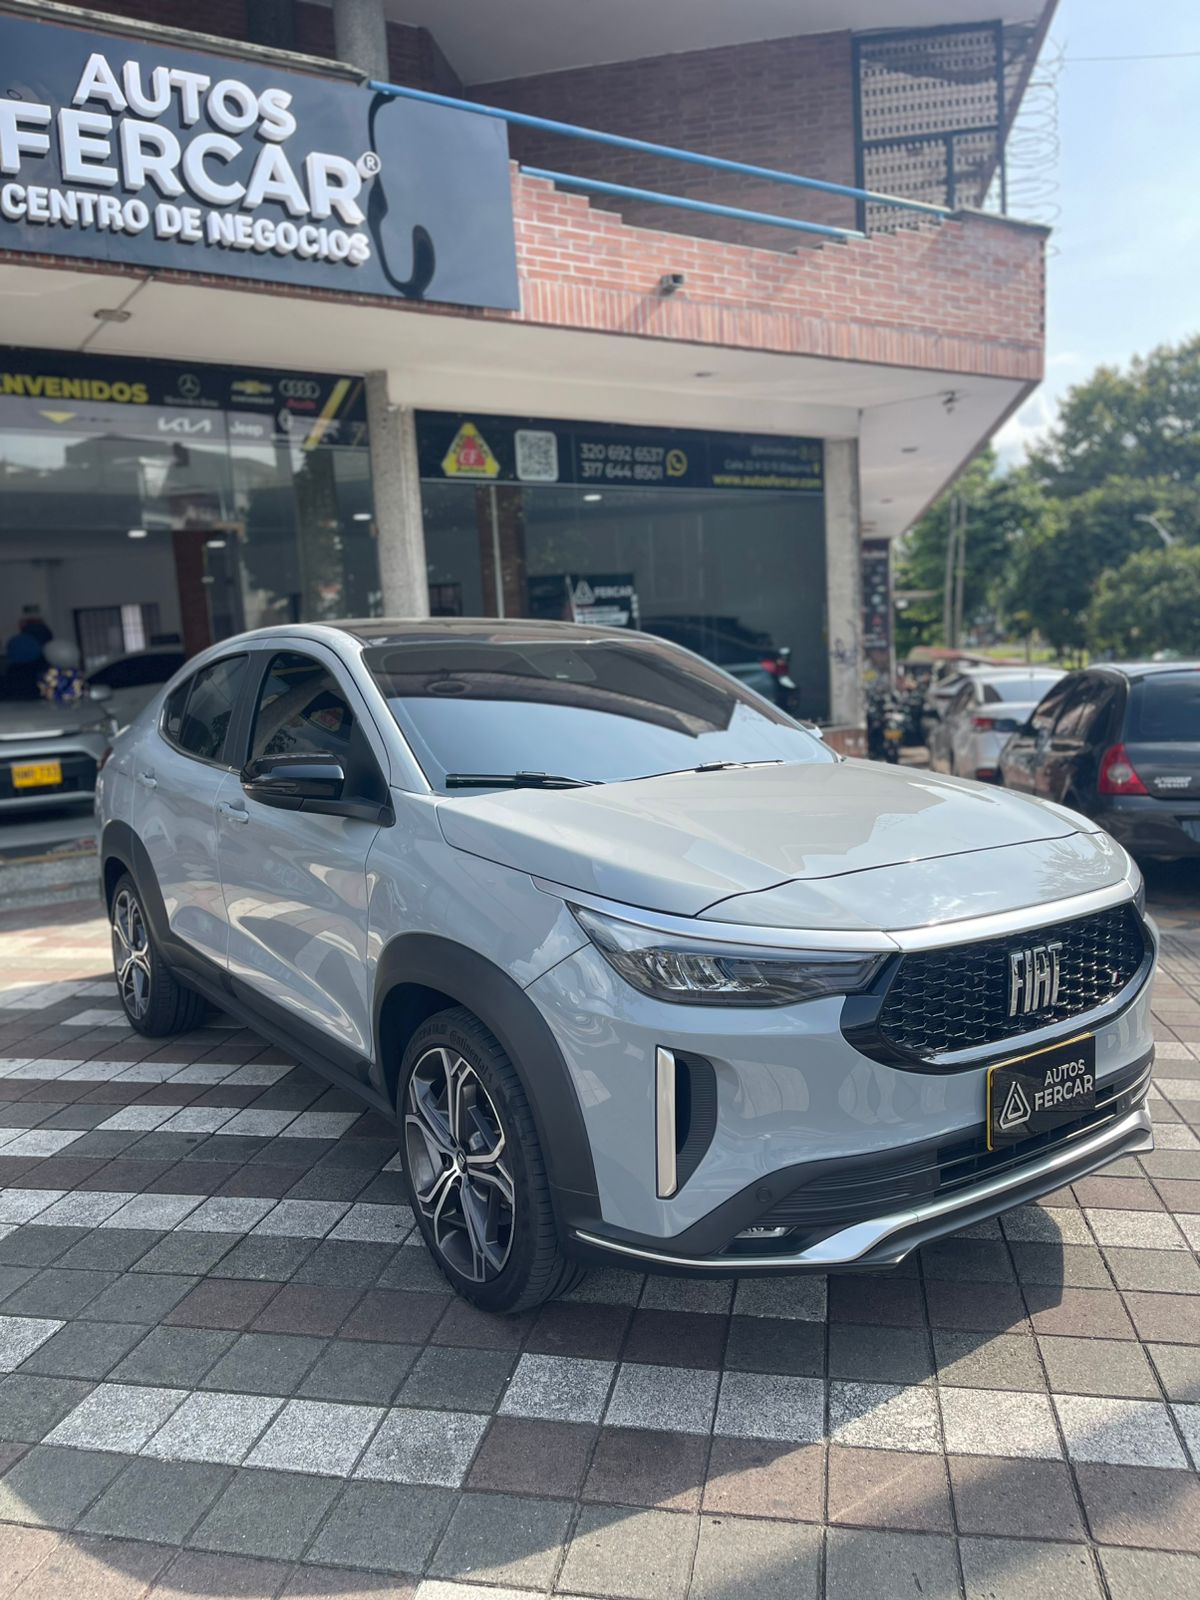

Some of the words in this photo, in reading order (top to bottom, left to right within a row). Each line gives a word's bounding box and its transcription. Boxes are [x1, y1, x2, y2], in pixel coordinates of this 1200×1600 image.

[72, 52, 297, 142] AUTOS
[2, 183, 149, 234] CENTRO
[155, 203, 203, 242] DE
[207, 211, 371, 265] NEGOCIOS
[0, 373, 149, 403] NVENIDOS
[230, 420, 264, 437] Jeep
[1010, 942, 1063, 1017] FIAT
[1044, 1058, 1086, 1087] AUTOS
[1034, 1074, 1094, 1112] FERCAR
